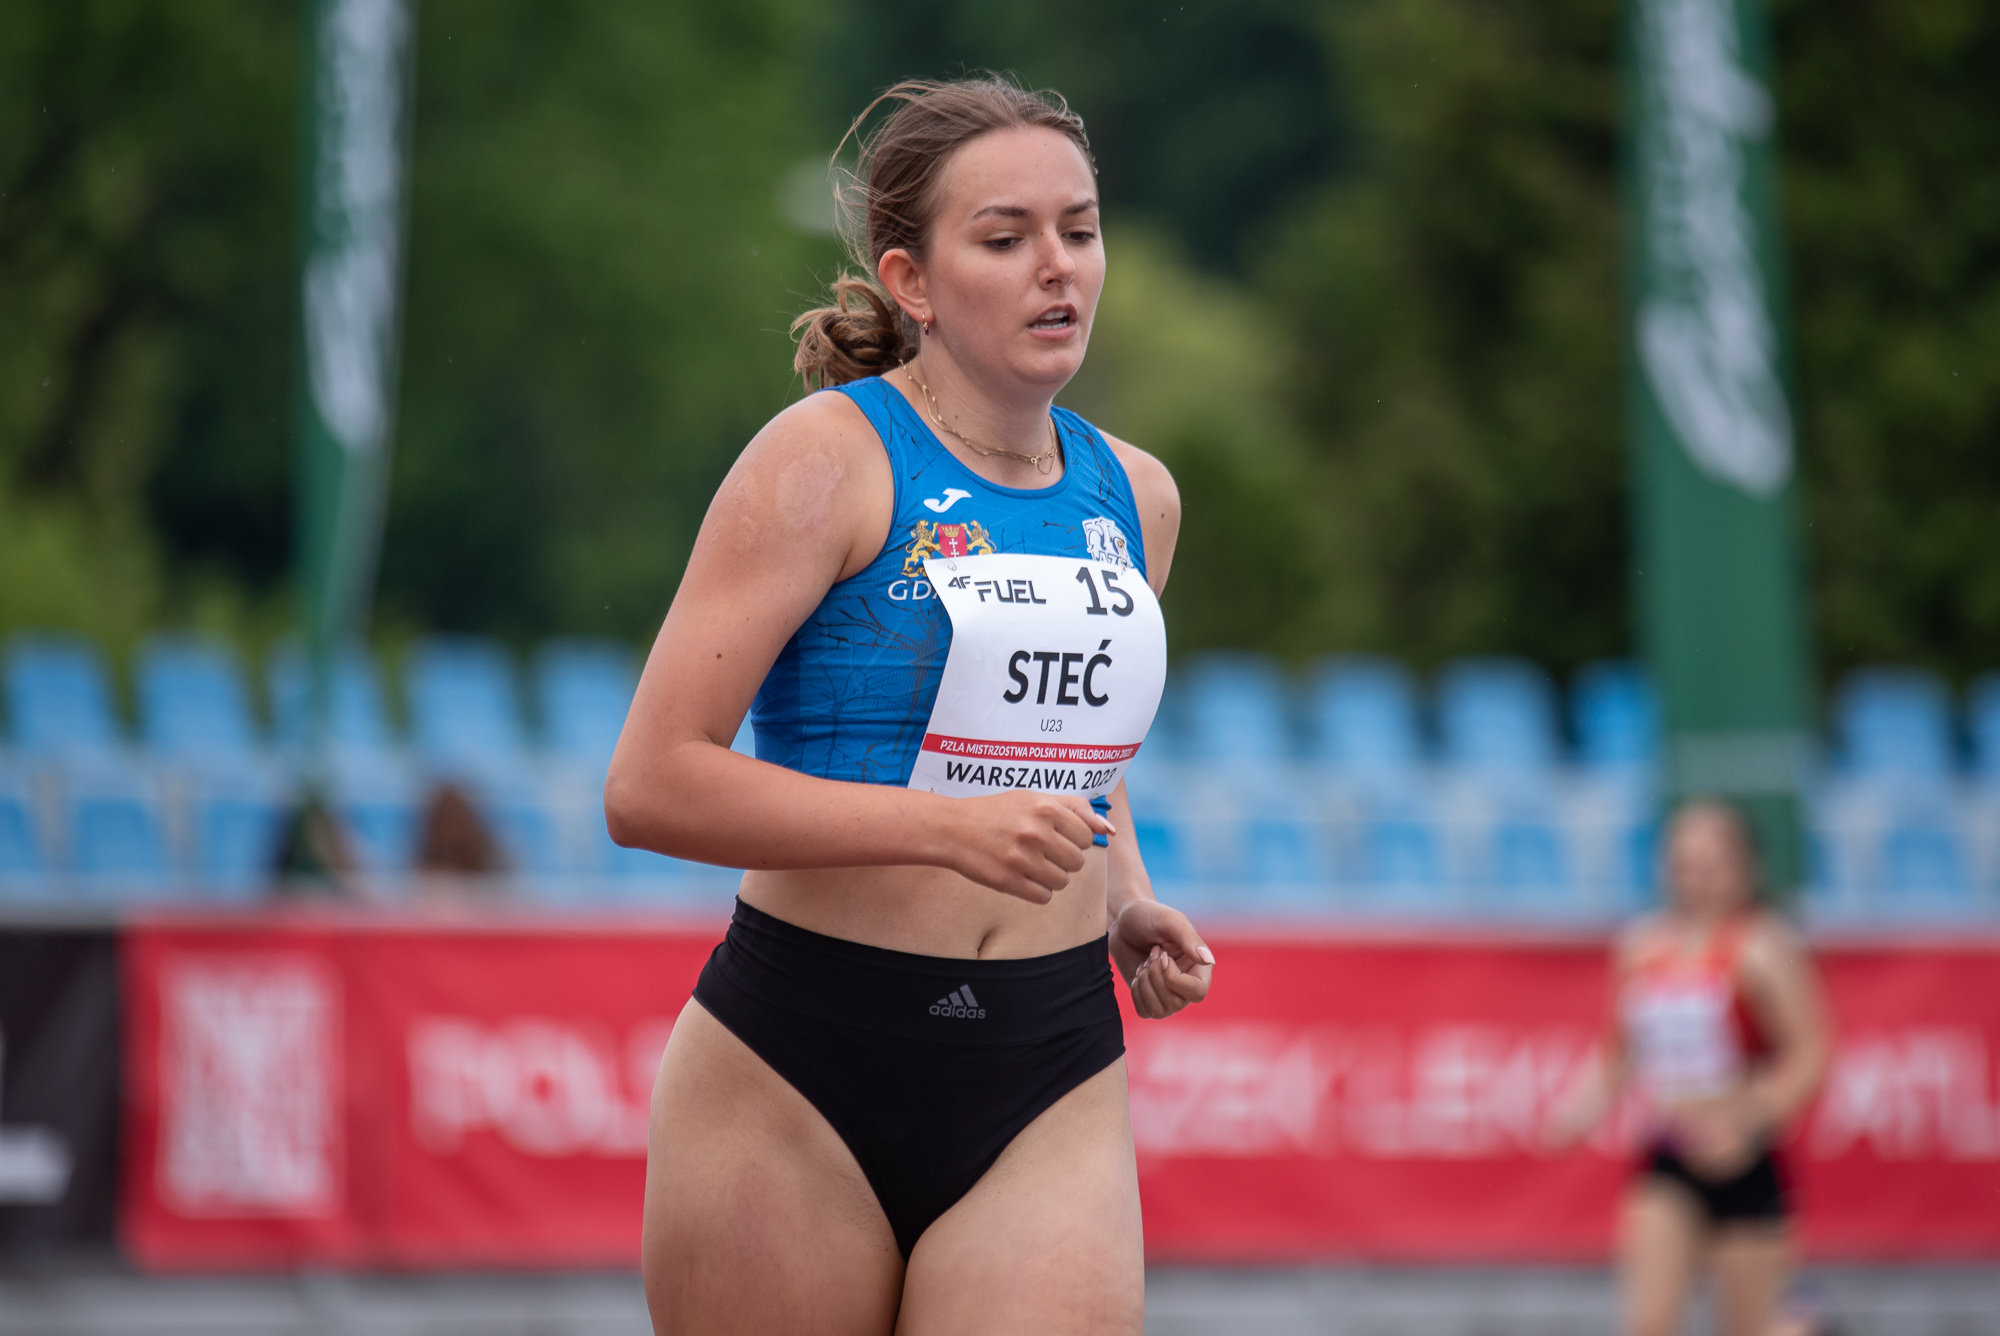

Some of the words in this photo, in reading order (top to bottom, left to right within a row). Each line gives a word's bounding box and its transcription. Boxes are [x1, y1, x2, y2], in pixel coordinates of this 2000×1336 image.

[974, 579, 1047, 604] FUEL
[1075, 566, 1134, 617] 15
[1003, 639, 1113, 707] STEĆ
[1040, 719, 1063, 732] U23
[940, 740, 965, 753] PZLA
[966, 743, 1028, 757] MISTRZOSTWA
[1029, 747, 1057, 759] POLSKI
[1059, 748, 1067, 759] W
[1068, 748, 1120, 760] WIELOBOJACH
[946, 761, 1076, 790] WARSZAWA
[1081, 767, 1117, 790] 2023
[929, 1004, 986, 1019] adidas
